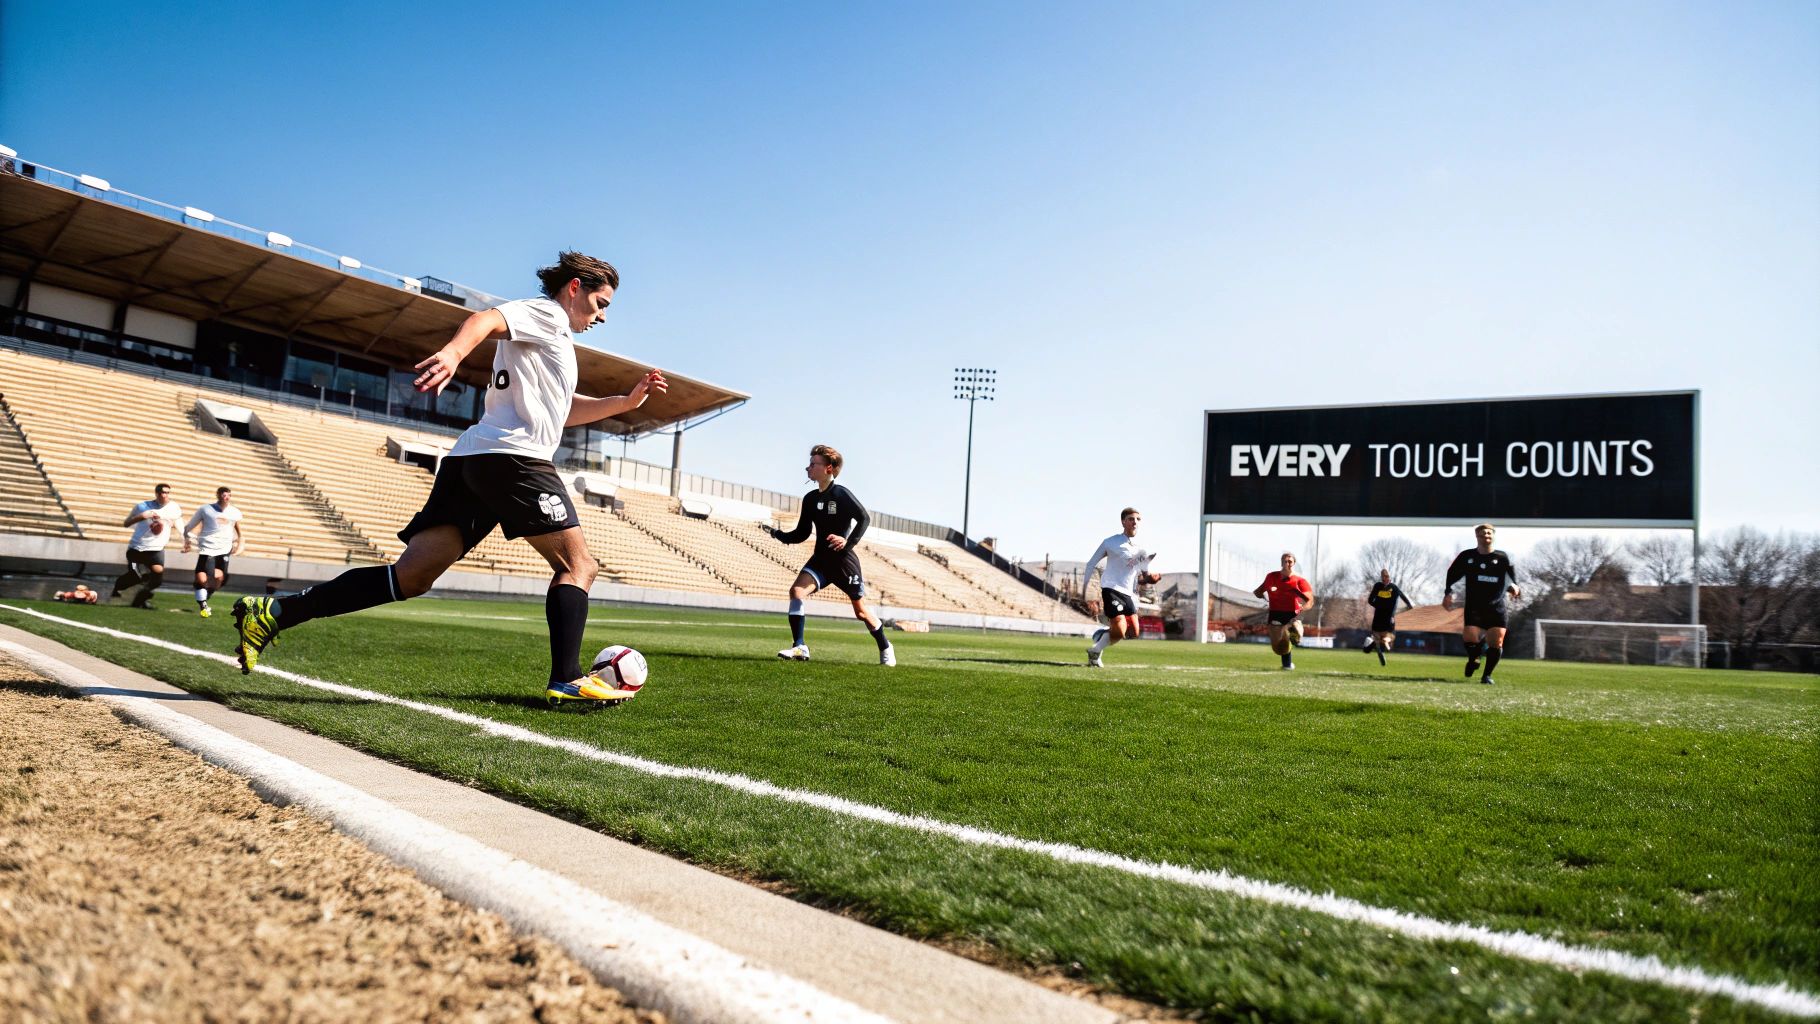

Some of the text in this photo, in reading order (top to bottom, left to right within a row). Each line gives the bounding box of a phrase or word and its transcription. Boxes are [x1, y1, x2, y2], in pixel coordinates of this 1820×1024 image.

[1230, 439, 1654, 478] EVERY TOUCH COUNTS
